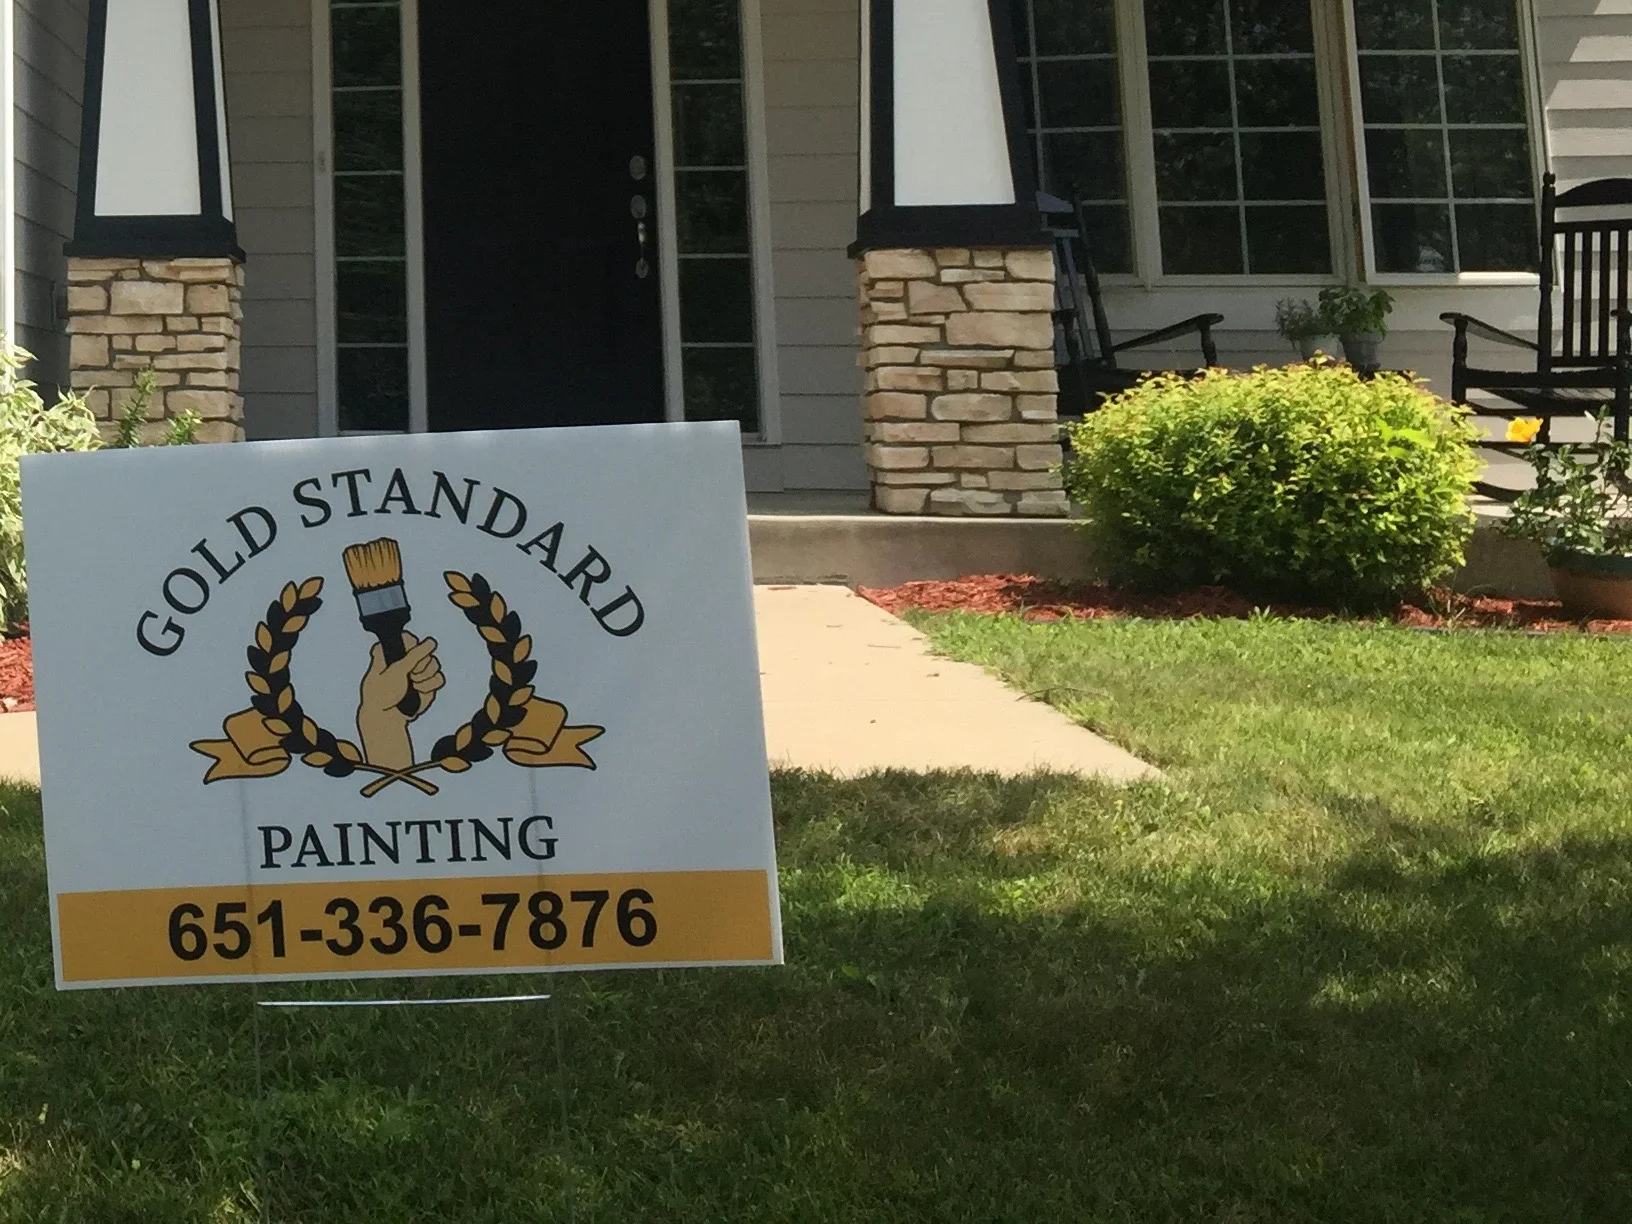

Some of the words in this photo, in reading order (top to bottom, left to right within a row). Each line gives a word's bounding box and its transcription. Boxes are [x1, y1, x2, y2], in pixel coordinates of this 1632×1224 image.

[135, 504, 279, 658] GOLD
[291, 467, 647, 639] STANDARD
[257, 814, 560, 870] PAINTING
[167, 887, 659, 962] 651-336-7876
